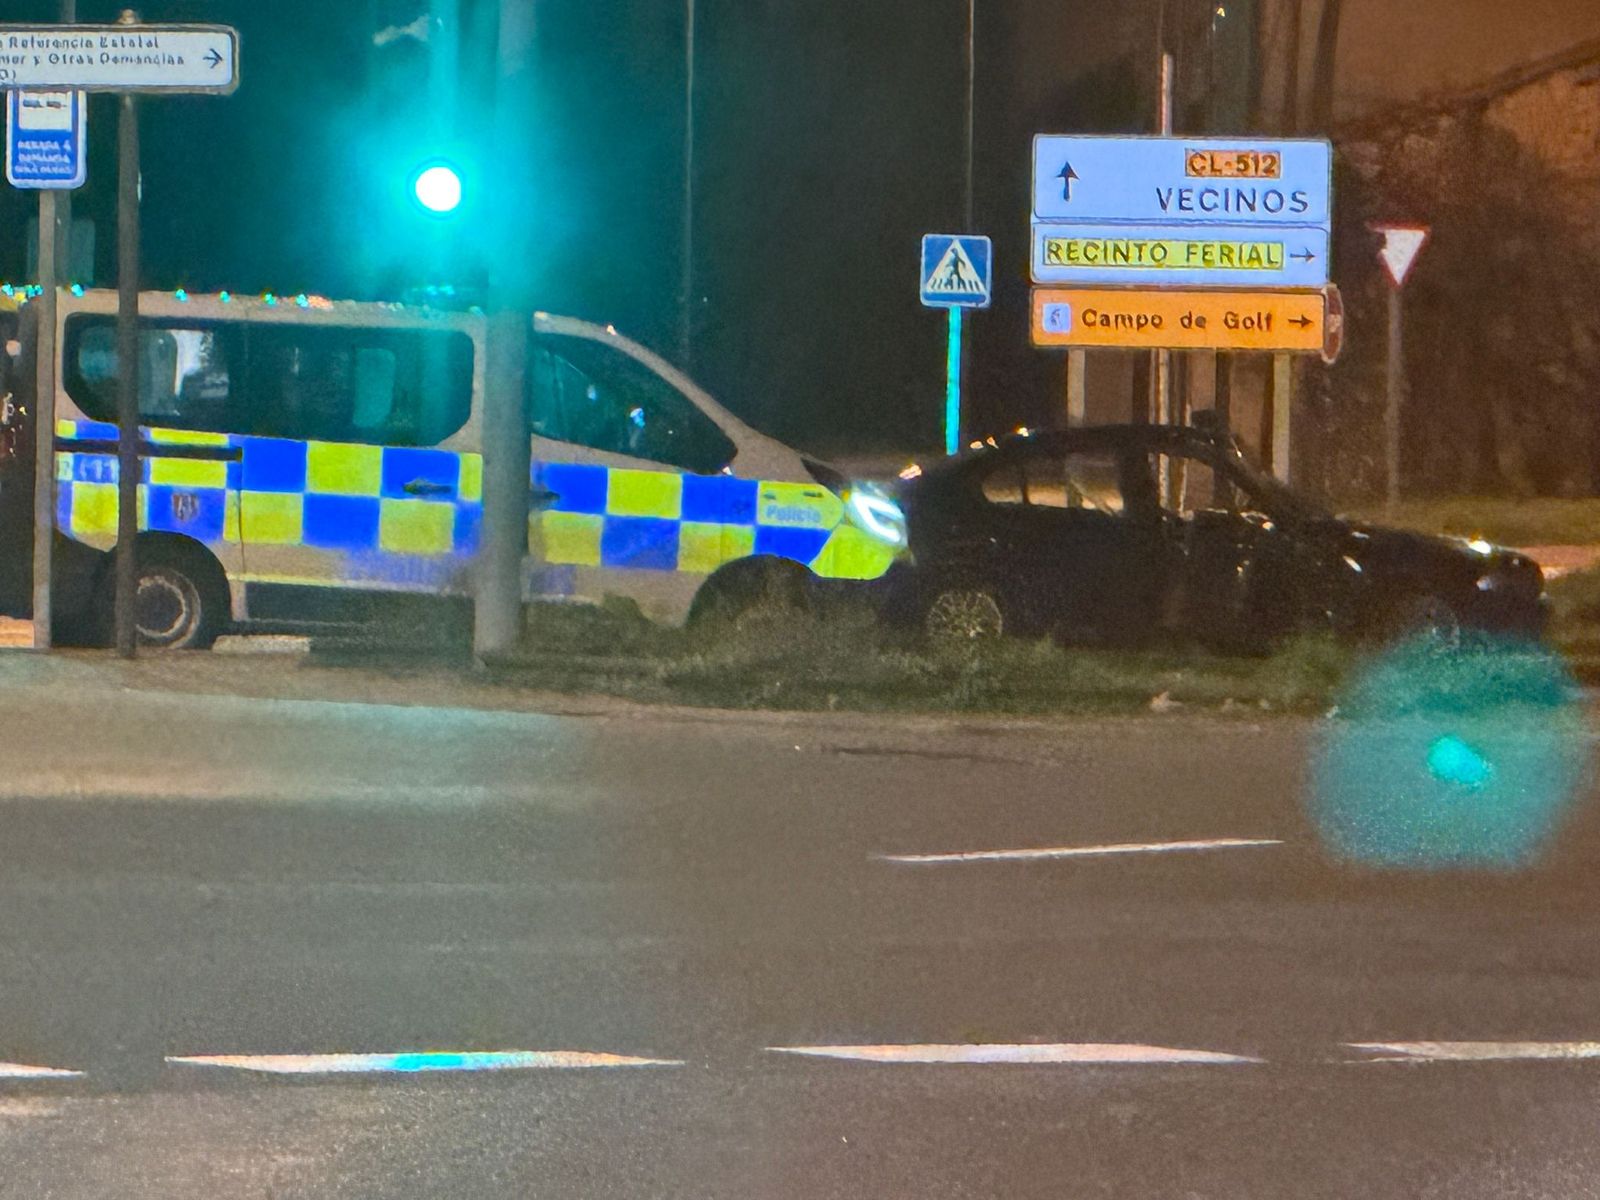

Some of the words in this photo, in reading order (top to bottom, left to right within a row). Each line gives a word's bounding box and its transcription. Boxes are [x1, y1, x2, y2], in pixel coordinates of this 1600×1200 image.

[1187, 151, 1278, 176] CL-512
[1156, 187, 1309, 213] VECINOS
[1047, 242, 1168, 263] RECINTO
[1186, 243, 1280, 265] FERIAL
[1081, 308, 1163, 334] Campo
[1180, 311, 1207, 330] de
[1223, 310, 1273, 331] Golf
